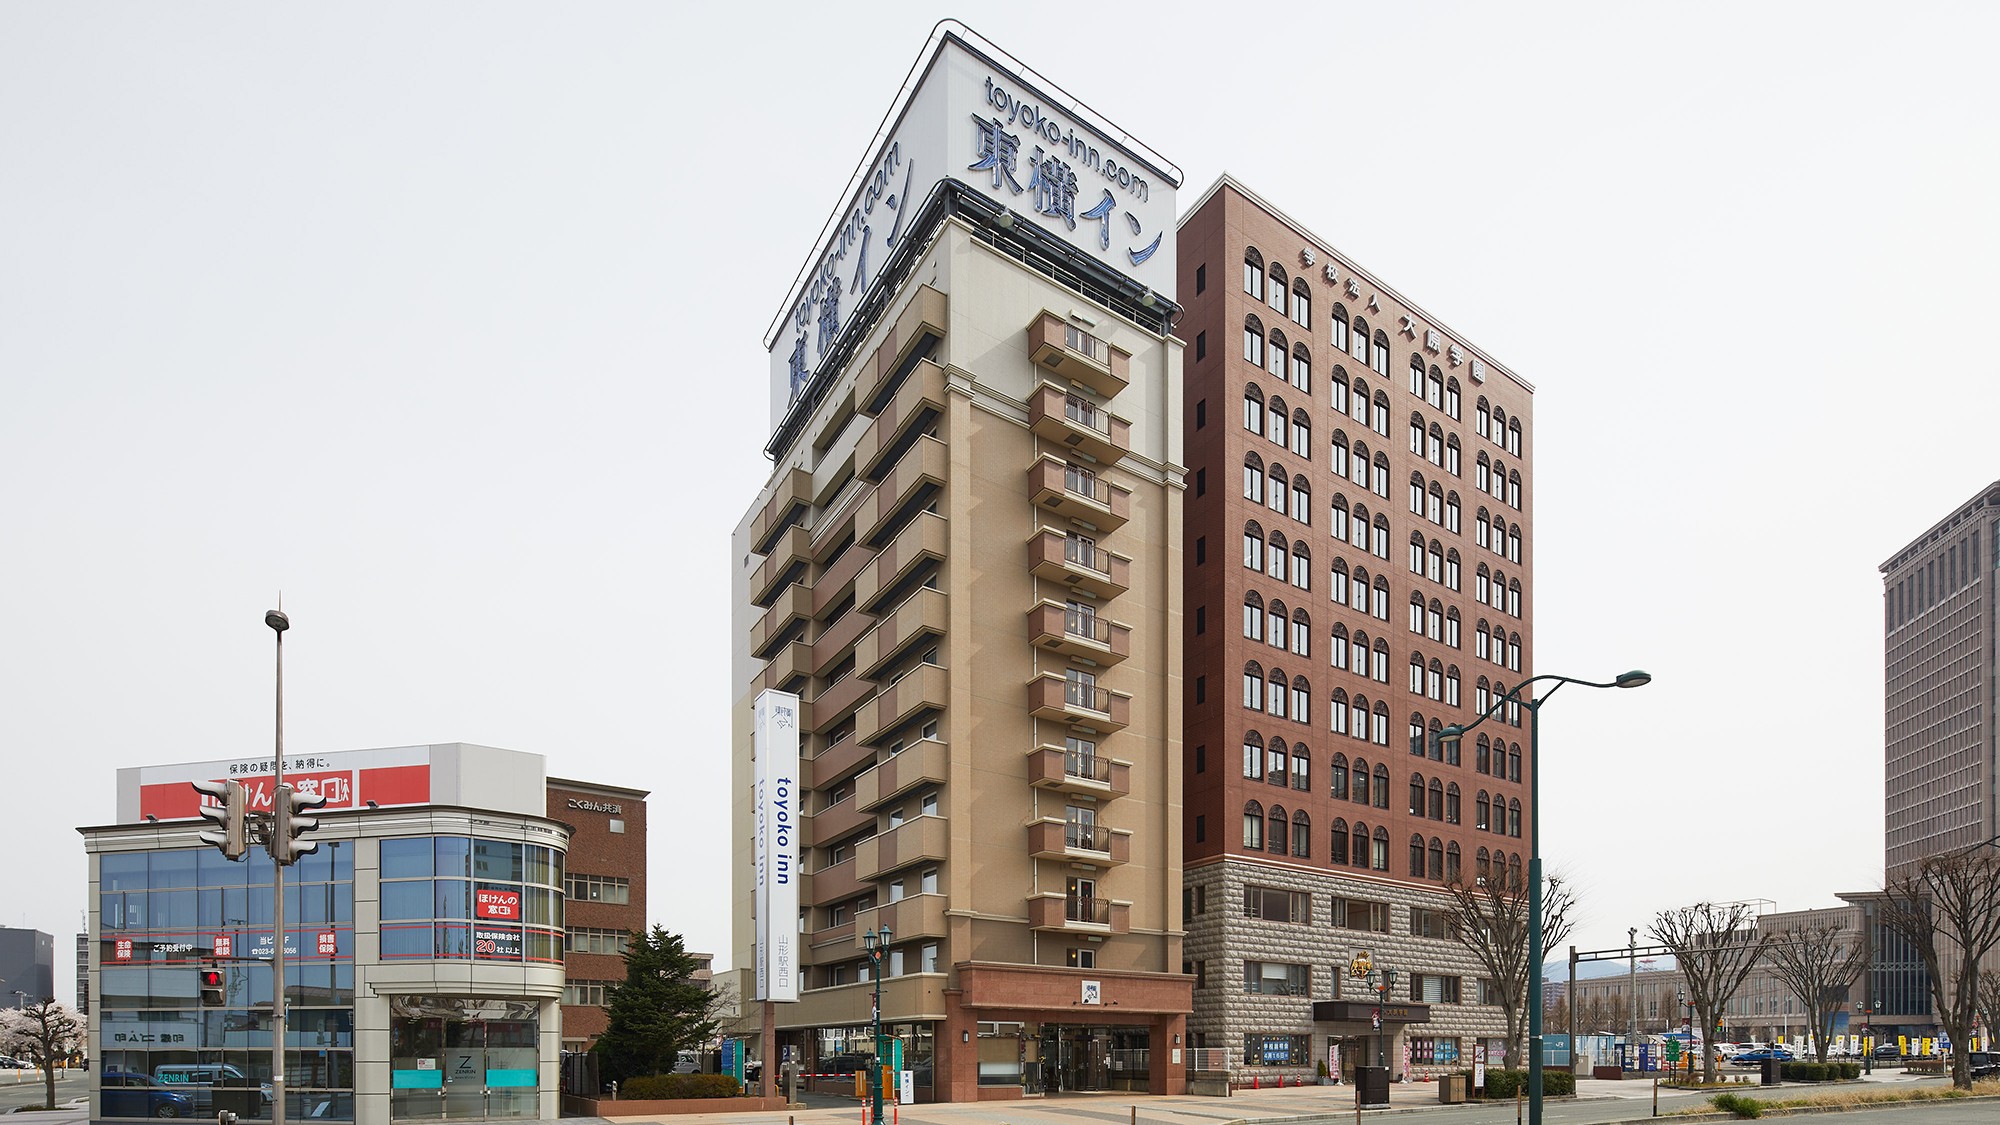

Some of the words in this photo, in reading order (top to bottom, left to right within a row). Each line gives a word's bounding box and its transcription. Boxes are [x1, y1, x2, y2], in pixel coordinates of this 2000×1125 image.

[985, 76, 1149, 203] toyoko-inn.com
[967, 112, 1163, 266] 東横イン
[795, 141, 900, 334] toyoko-inn.com
[568, 798, 622, 815] こくみん共済
[758, 778, 766, 849] toyoko
[774, 777, 792, 847] toyoko
[777, 854, 792, 885] inn
[478, 894, 518, 905] ほけんの
[117, 940, 132, 949] 生命
[215, 937, 230, 946] 無料
[476, 931, 520, 941] 取扱保険会社
[117, 949, 132, 959] 保険
[319, 943, 334, 953] 保険
[778, 934, 789, 988] 山形駅西口
[157, 1073, 189, 1083] ZENRIN
